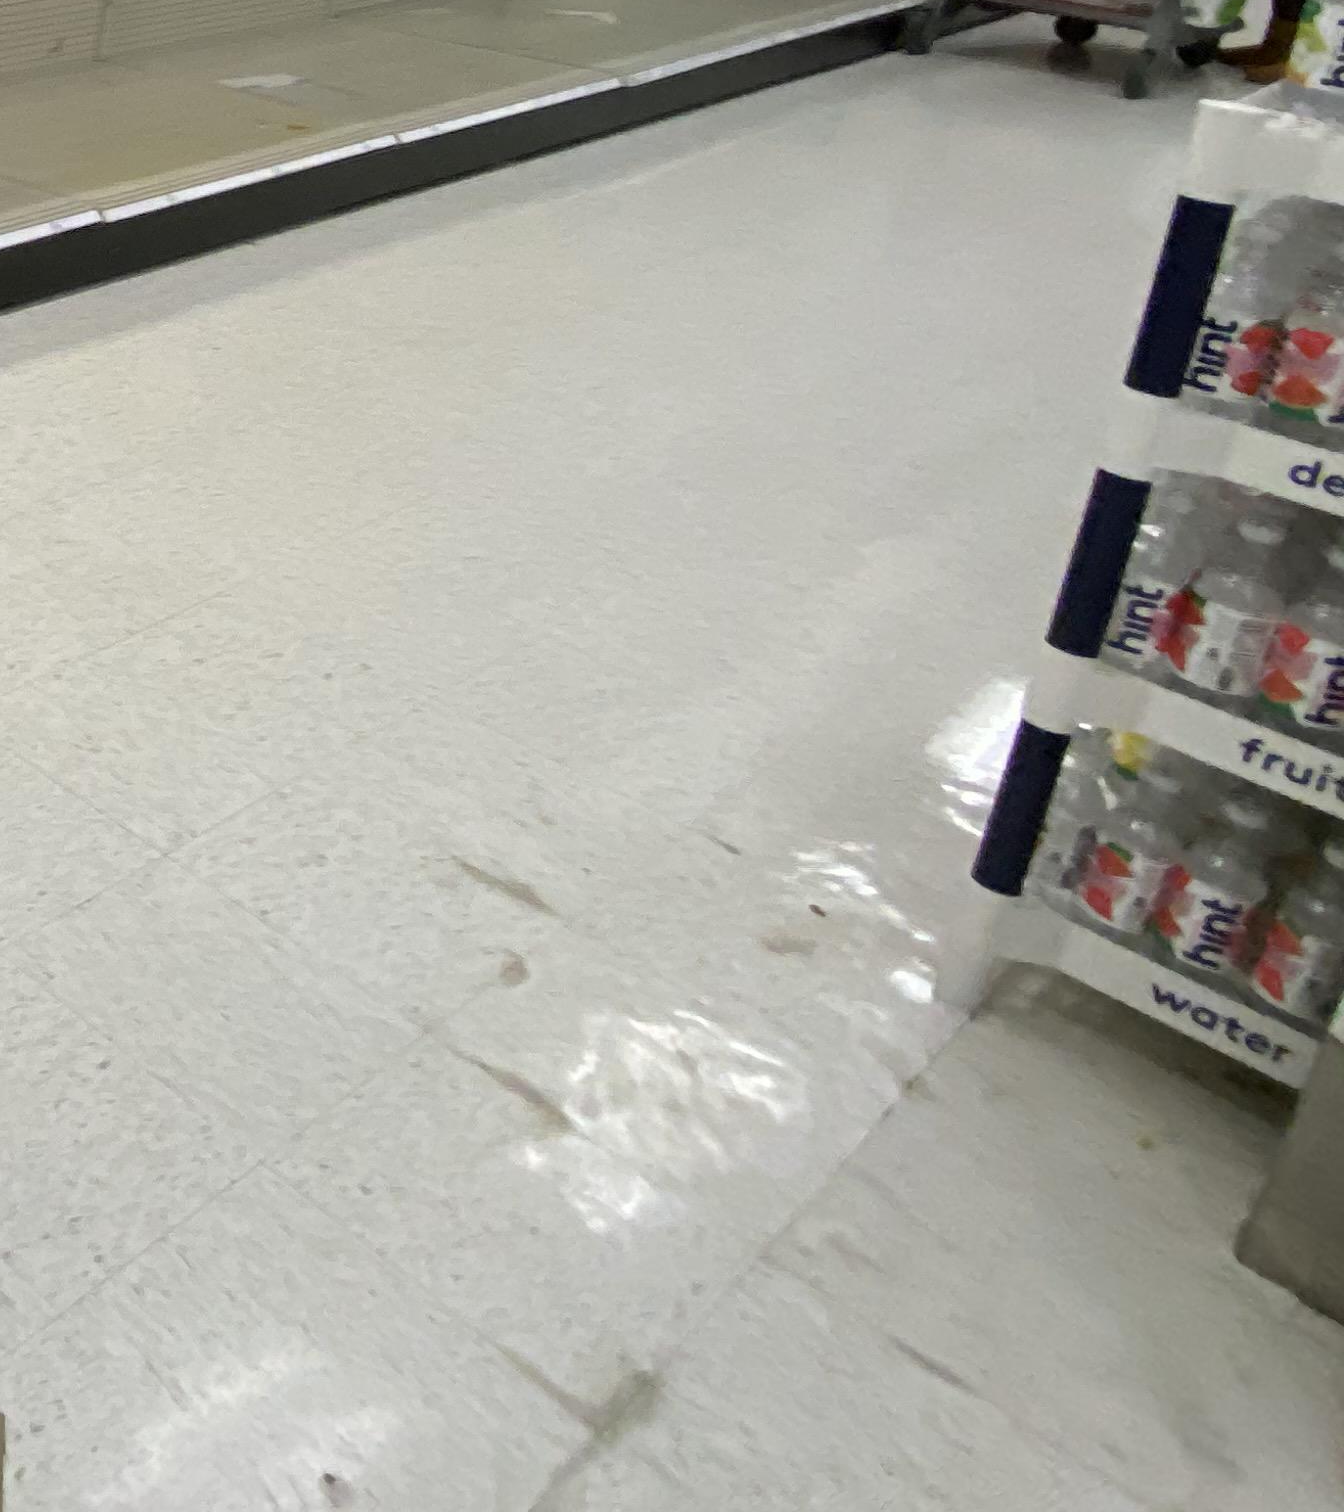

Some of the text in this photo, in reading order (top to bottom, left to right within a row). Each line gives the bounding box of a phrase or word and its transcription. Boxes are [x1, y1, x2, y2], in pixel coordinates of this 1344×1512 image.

[1183, 317, 1239, 393] hint
[1107, 584, 1164, 655] hint
[1182, 898, 1243, 971] hint
[1150, 982, 1293, 1062] water
